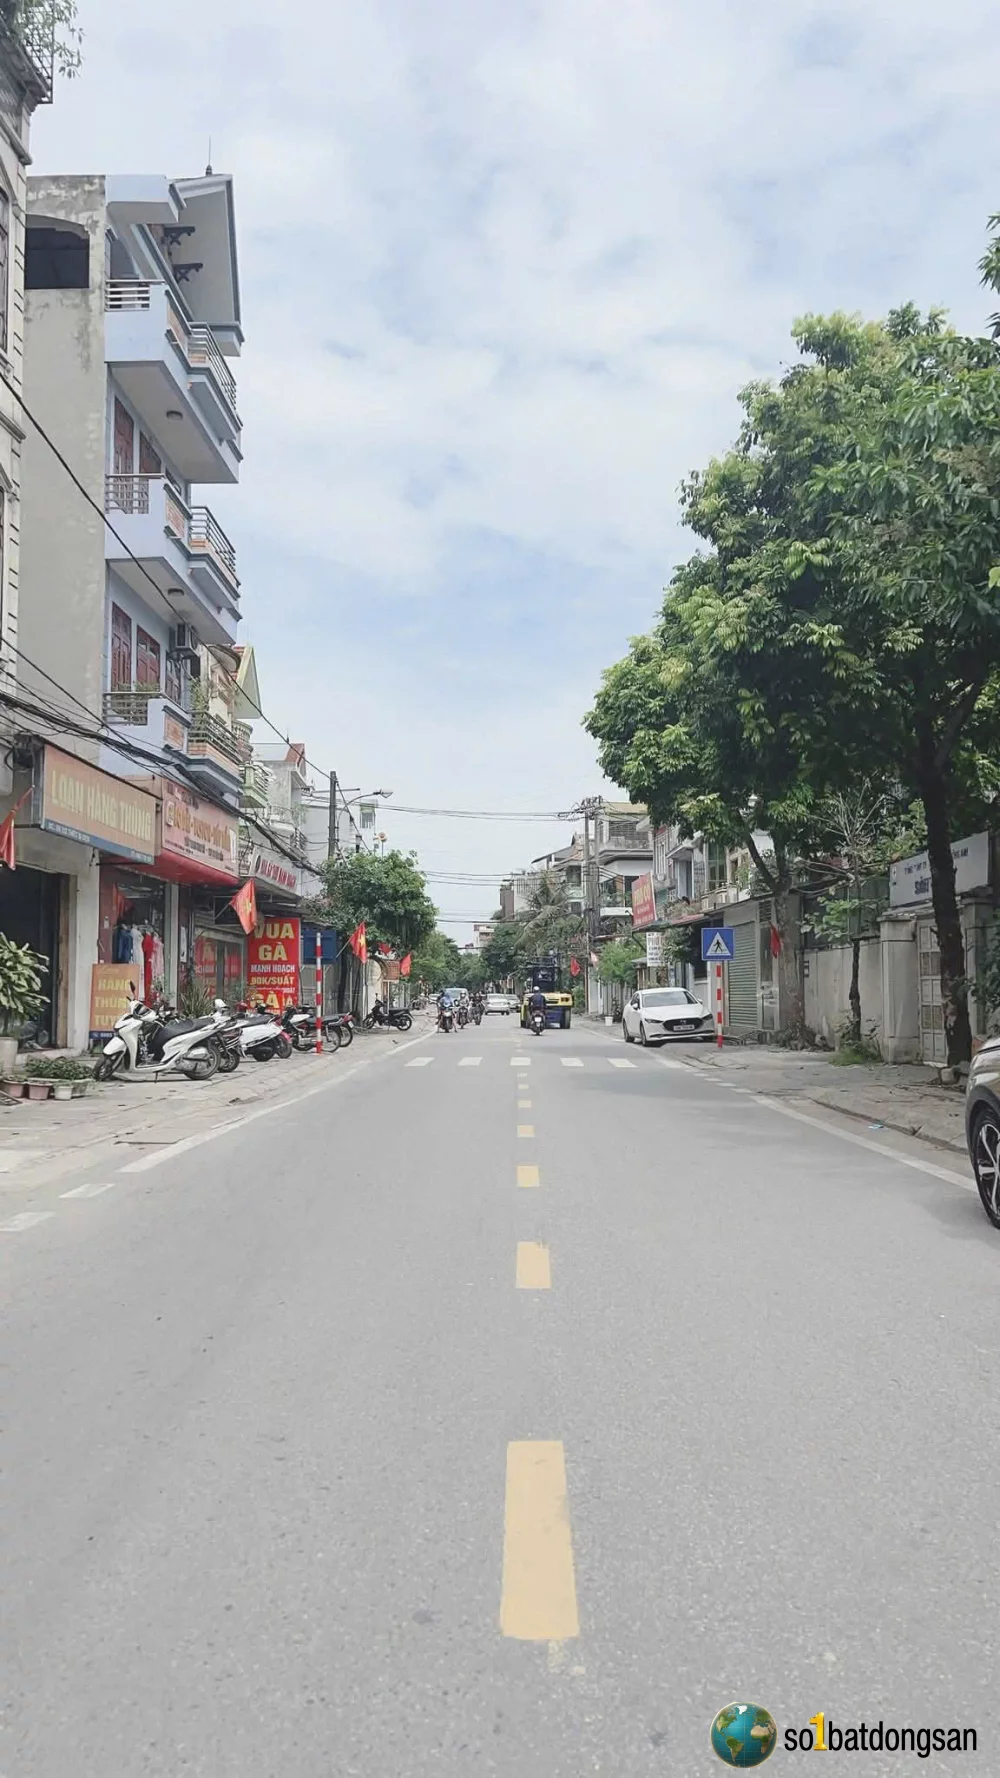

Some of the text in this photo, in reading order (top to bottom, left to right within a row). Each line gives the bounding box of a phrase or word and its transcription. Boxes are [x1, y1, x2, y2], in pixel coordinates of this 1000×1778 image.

[87, 782, 117, 829] HÀNG
[120, 799, 152, 841] THÙNG
[255, 924, 294, 939] VUA
[259, 942, 287, 961] GÀ
[272, 964, 296, 975] HOẠCH
